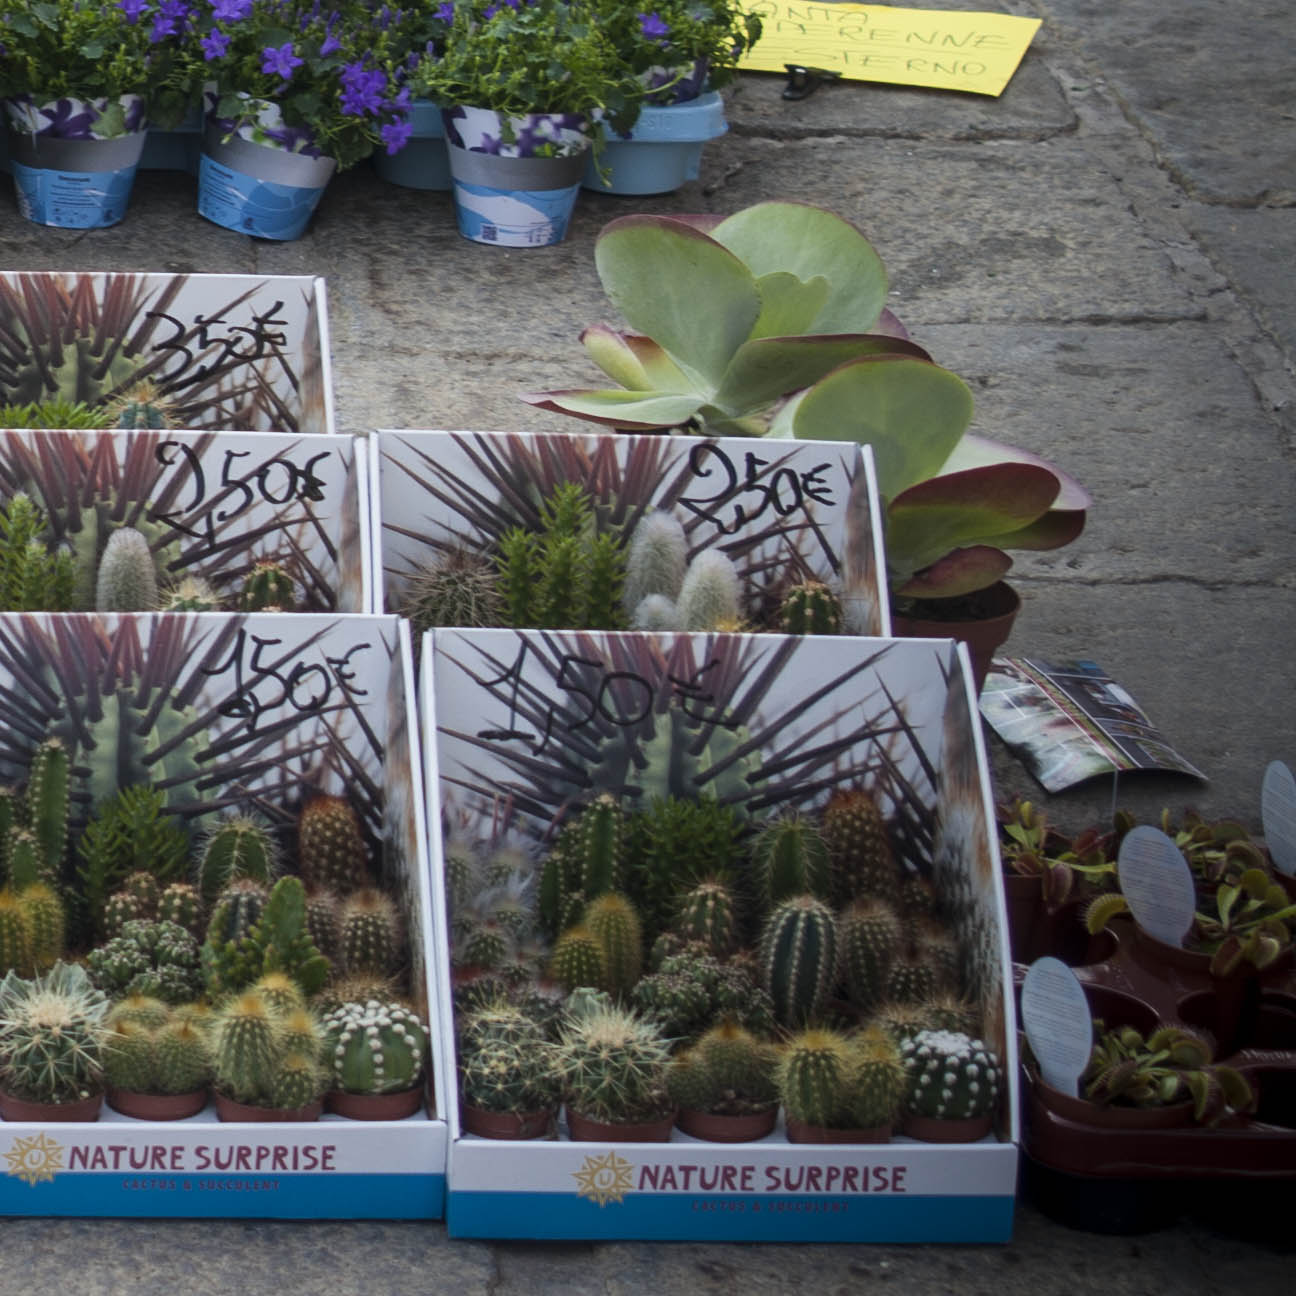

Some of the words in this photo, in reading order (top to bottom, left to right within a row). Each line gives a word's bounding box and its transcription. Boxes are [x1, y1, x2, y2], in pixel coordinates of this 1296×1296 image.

[67, 1144, 186, 1171] NATURE
[194, 1145, 337, 1171] SURPRISE
[637, 1164, 756, 1192] NATURE
[764, 1165, 908, 1193] SURPRISE
